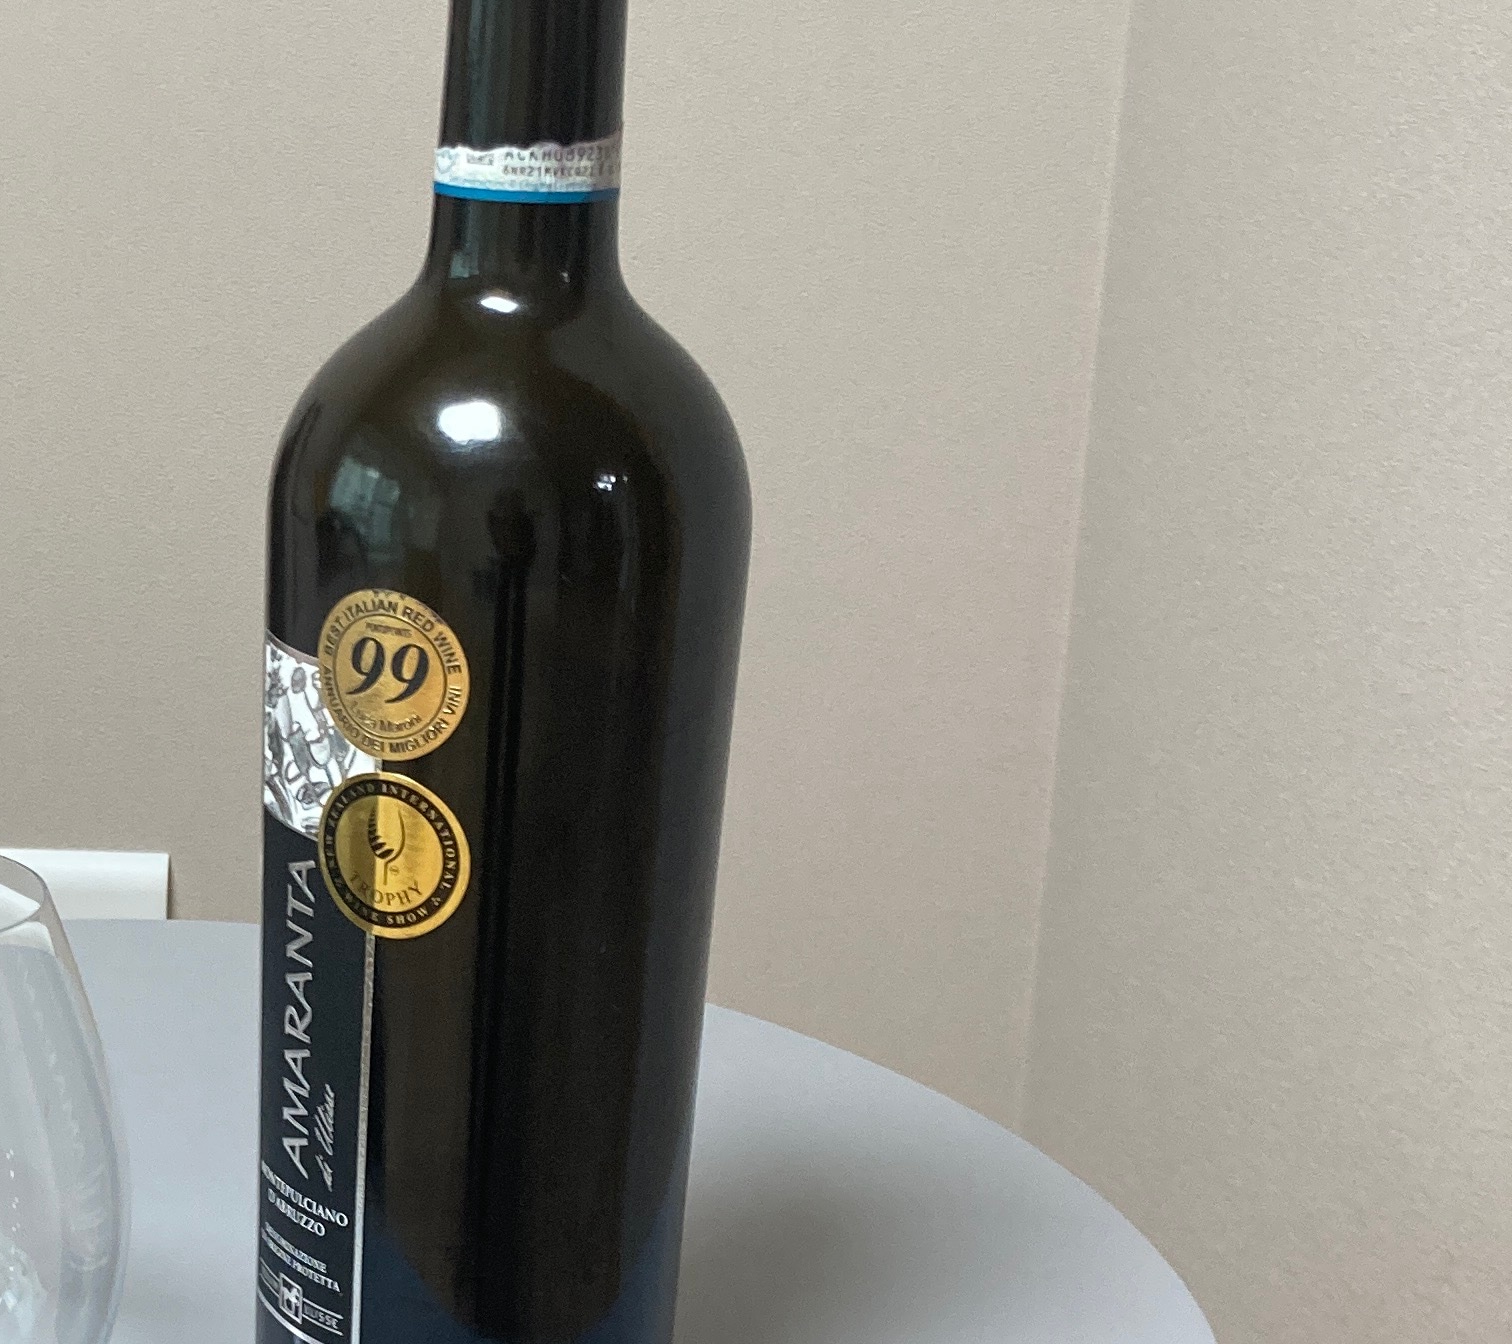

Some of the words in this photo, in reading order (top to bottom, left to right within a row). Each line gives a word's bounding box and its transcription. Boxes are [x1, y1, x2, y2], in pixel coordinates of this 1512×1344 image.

[325, 617, 344, 656] BEST
[342, 599, 399, 623] ITALIAN
[402, 606, 434, 632] RED
[433, 631, 462, 674] WINE
[346, 636, 431, 704] 99
[361, 735, 385, 753] DEI
[389, 717, 449, 754] MIGLIORI
[442, 686, 463, 715] VINI
[381, 783, 457, 889] INTERNATIONAL
[349, 871, 423, 906] TROPHY
[386, 906, 429, 925] SHOW
[281, 859, 317, 1180] AMARANTA
